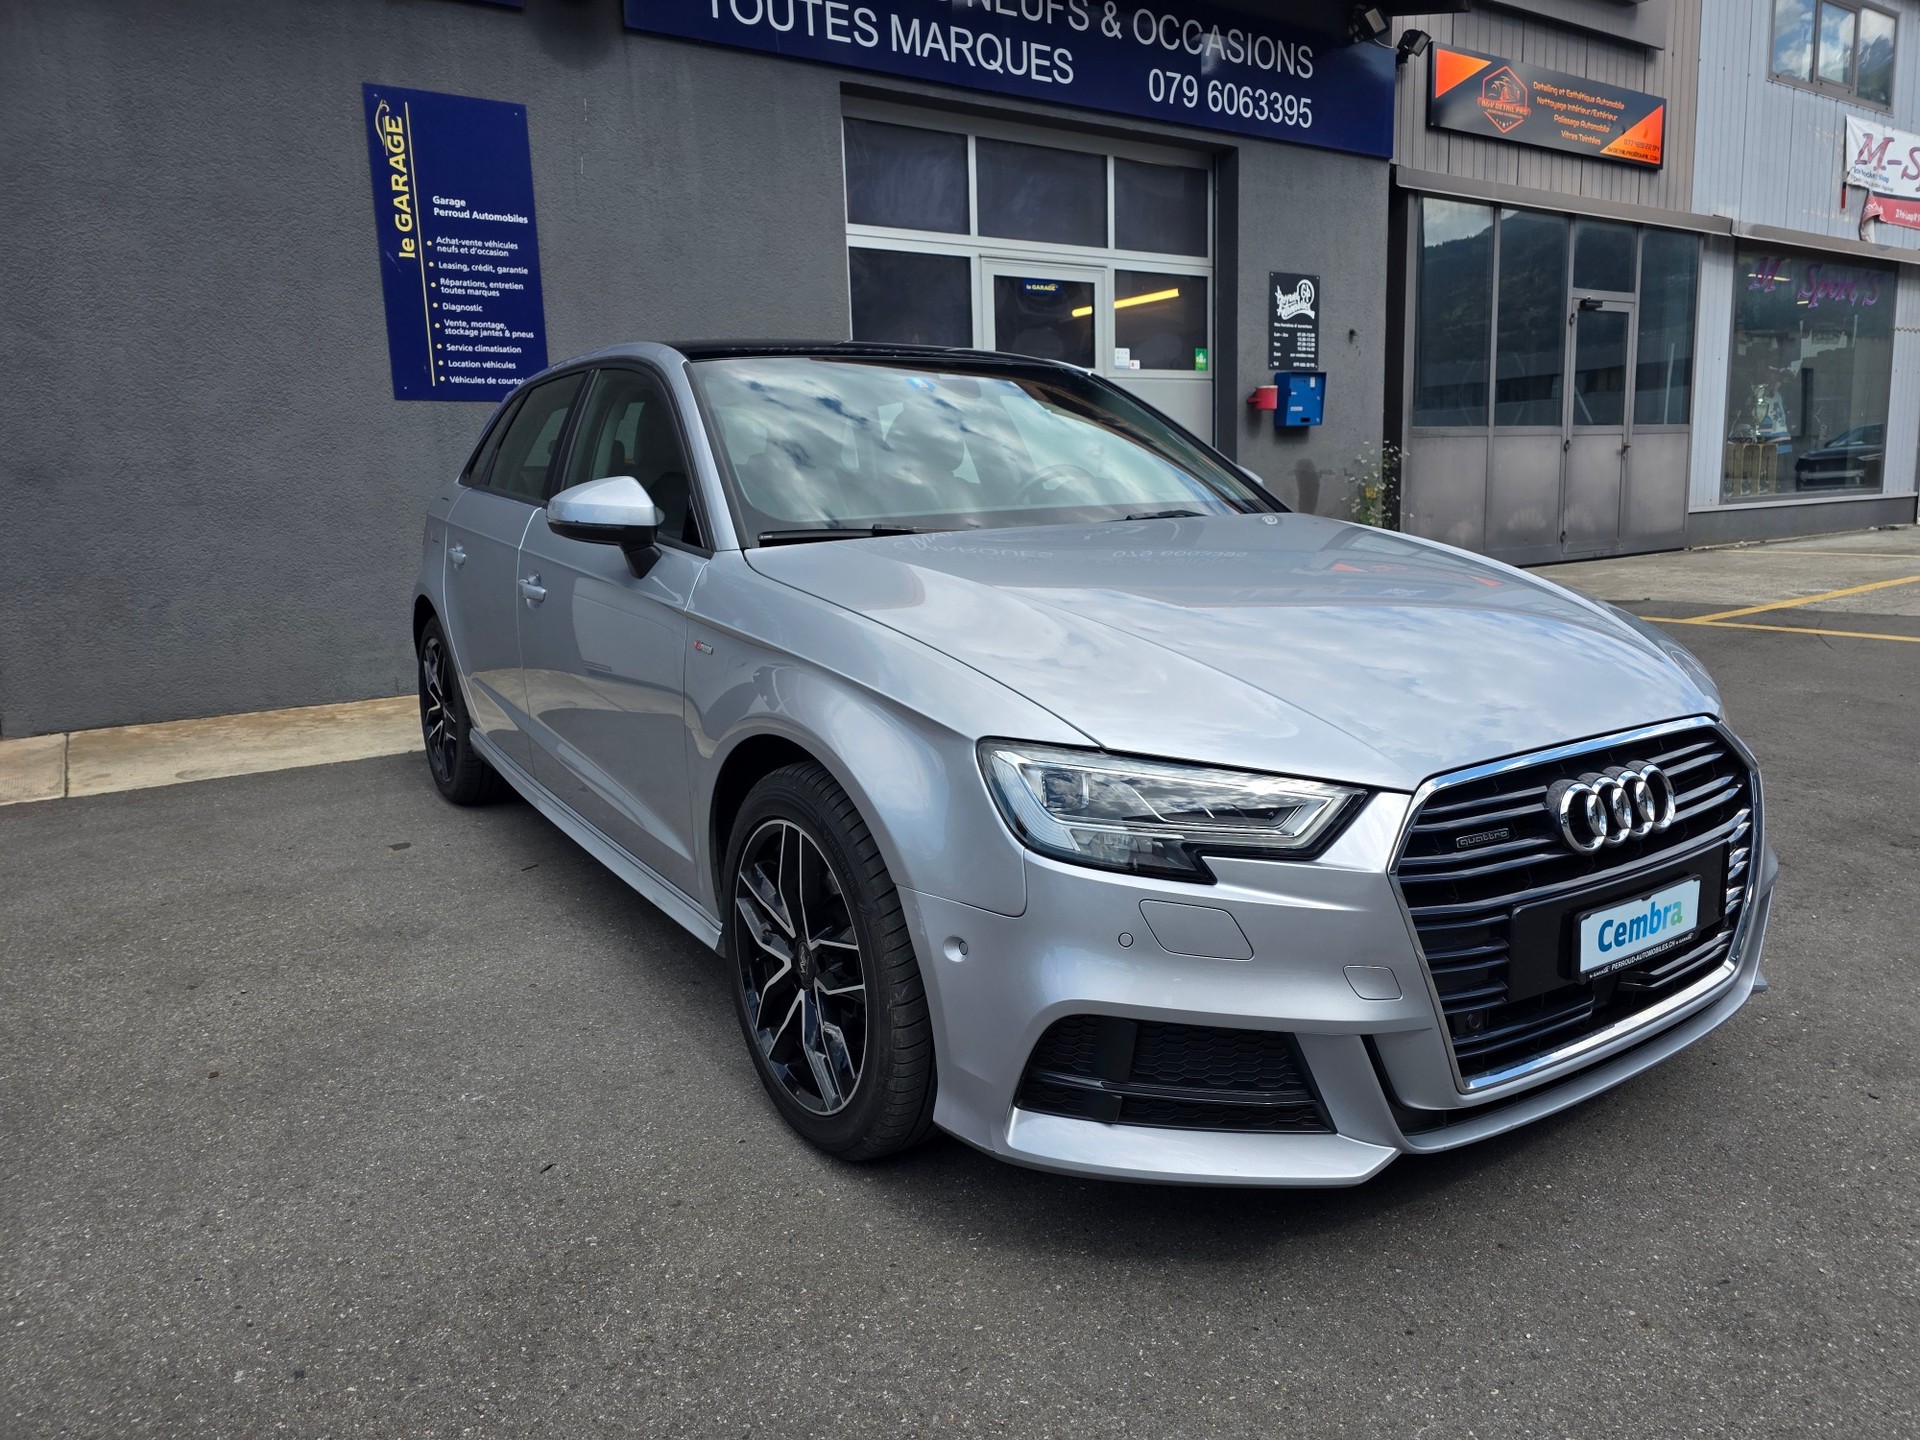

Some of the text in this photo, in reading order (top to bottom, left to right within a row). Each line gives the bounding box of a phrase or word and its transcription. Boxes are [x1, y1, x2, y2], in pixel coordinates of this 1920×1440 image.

[967, 0, 1314, 79] UFS & OCCASIONS
[890, 14, 1074, 85] MARQUES
[1149, 68, 1313, 128] 079 6063395
[1533, 81, 1625, 110] Detailing et Esthétique Automobile
[1536, 96, 1567, 111] Nettoyage
[1553, 114, 1610, 133] Polissage Automobile
[1561, 130, 1578, 140] Vitres
[384, 115, 416, 259] le GARAGE
[432, 195, 466, 208] Garage
[433, 207, 528, 224] Perroud Automobiles
[436, 236, 518, 250] Achat-vente véhicules
[437, 245, 458, 253] neufs
[470, 247, 509, 257] d'occasion
[438, 261, 528, 275] Leasing, crédit, garantie
[440, 277, 524, 290] Réparations, entretien
[441, 287, 500, 297] toutes marques
[442, 302, 483, 312] Diagnostic
[443, 319, 507, 330] Vente, montage,
[444, 328, 478, 337] stockage
[480, 329, 503, 337] jantes
[512, 331, 534, 339] pneus
[446, 343, 522, 353] Service climatisation
[448, 360, 516, 369] Location véhicules
[449, 375, 485, 384] Véhicules
[1460, 831, 1508, 846] quattro
[1598, 901, 1683, 952] Cembra
[1611, 940, 1676, 971] PERROUD-AUTOMOBILES.CH
